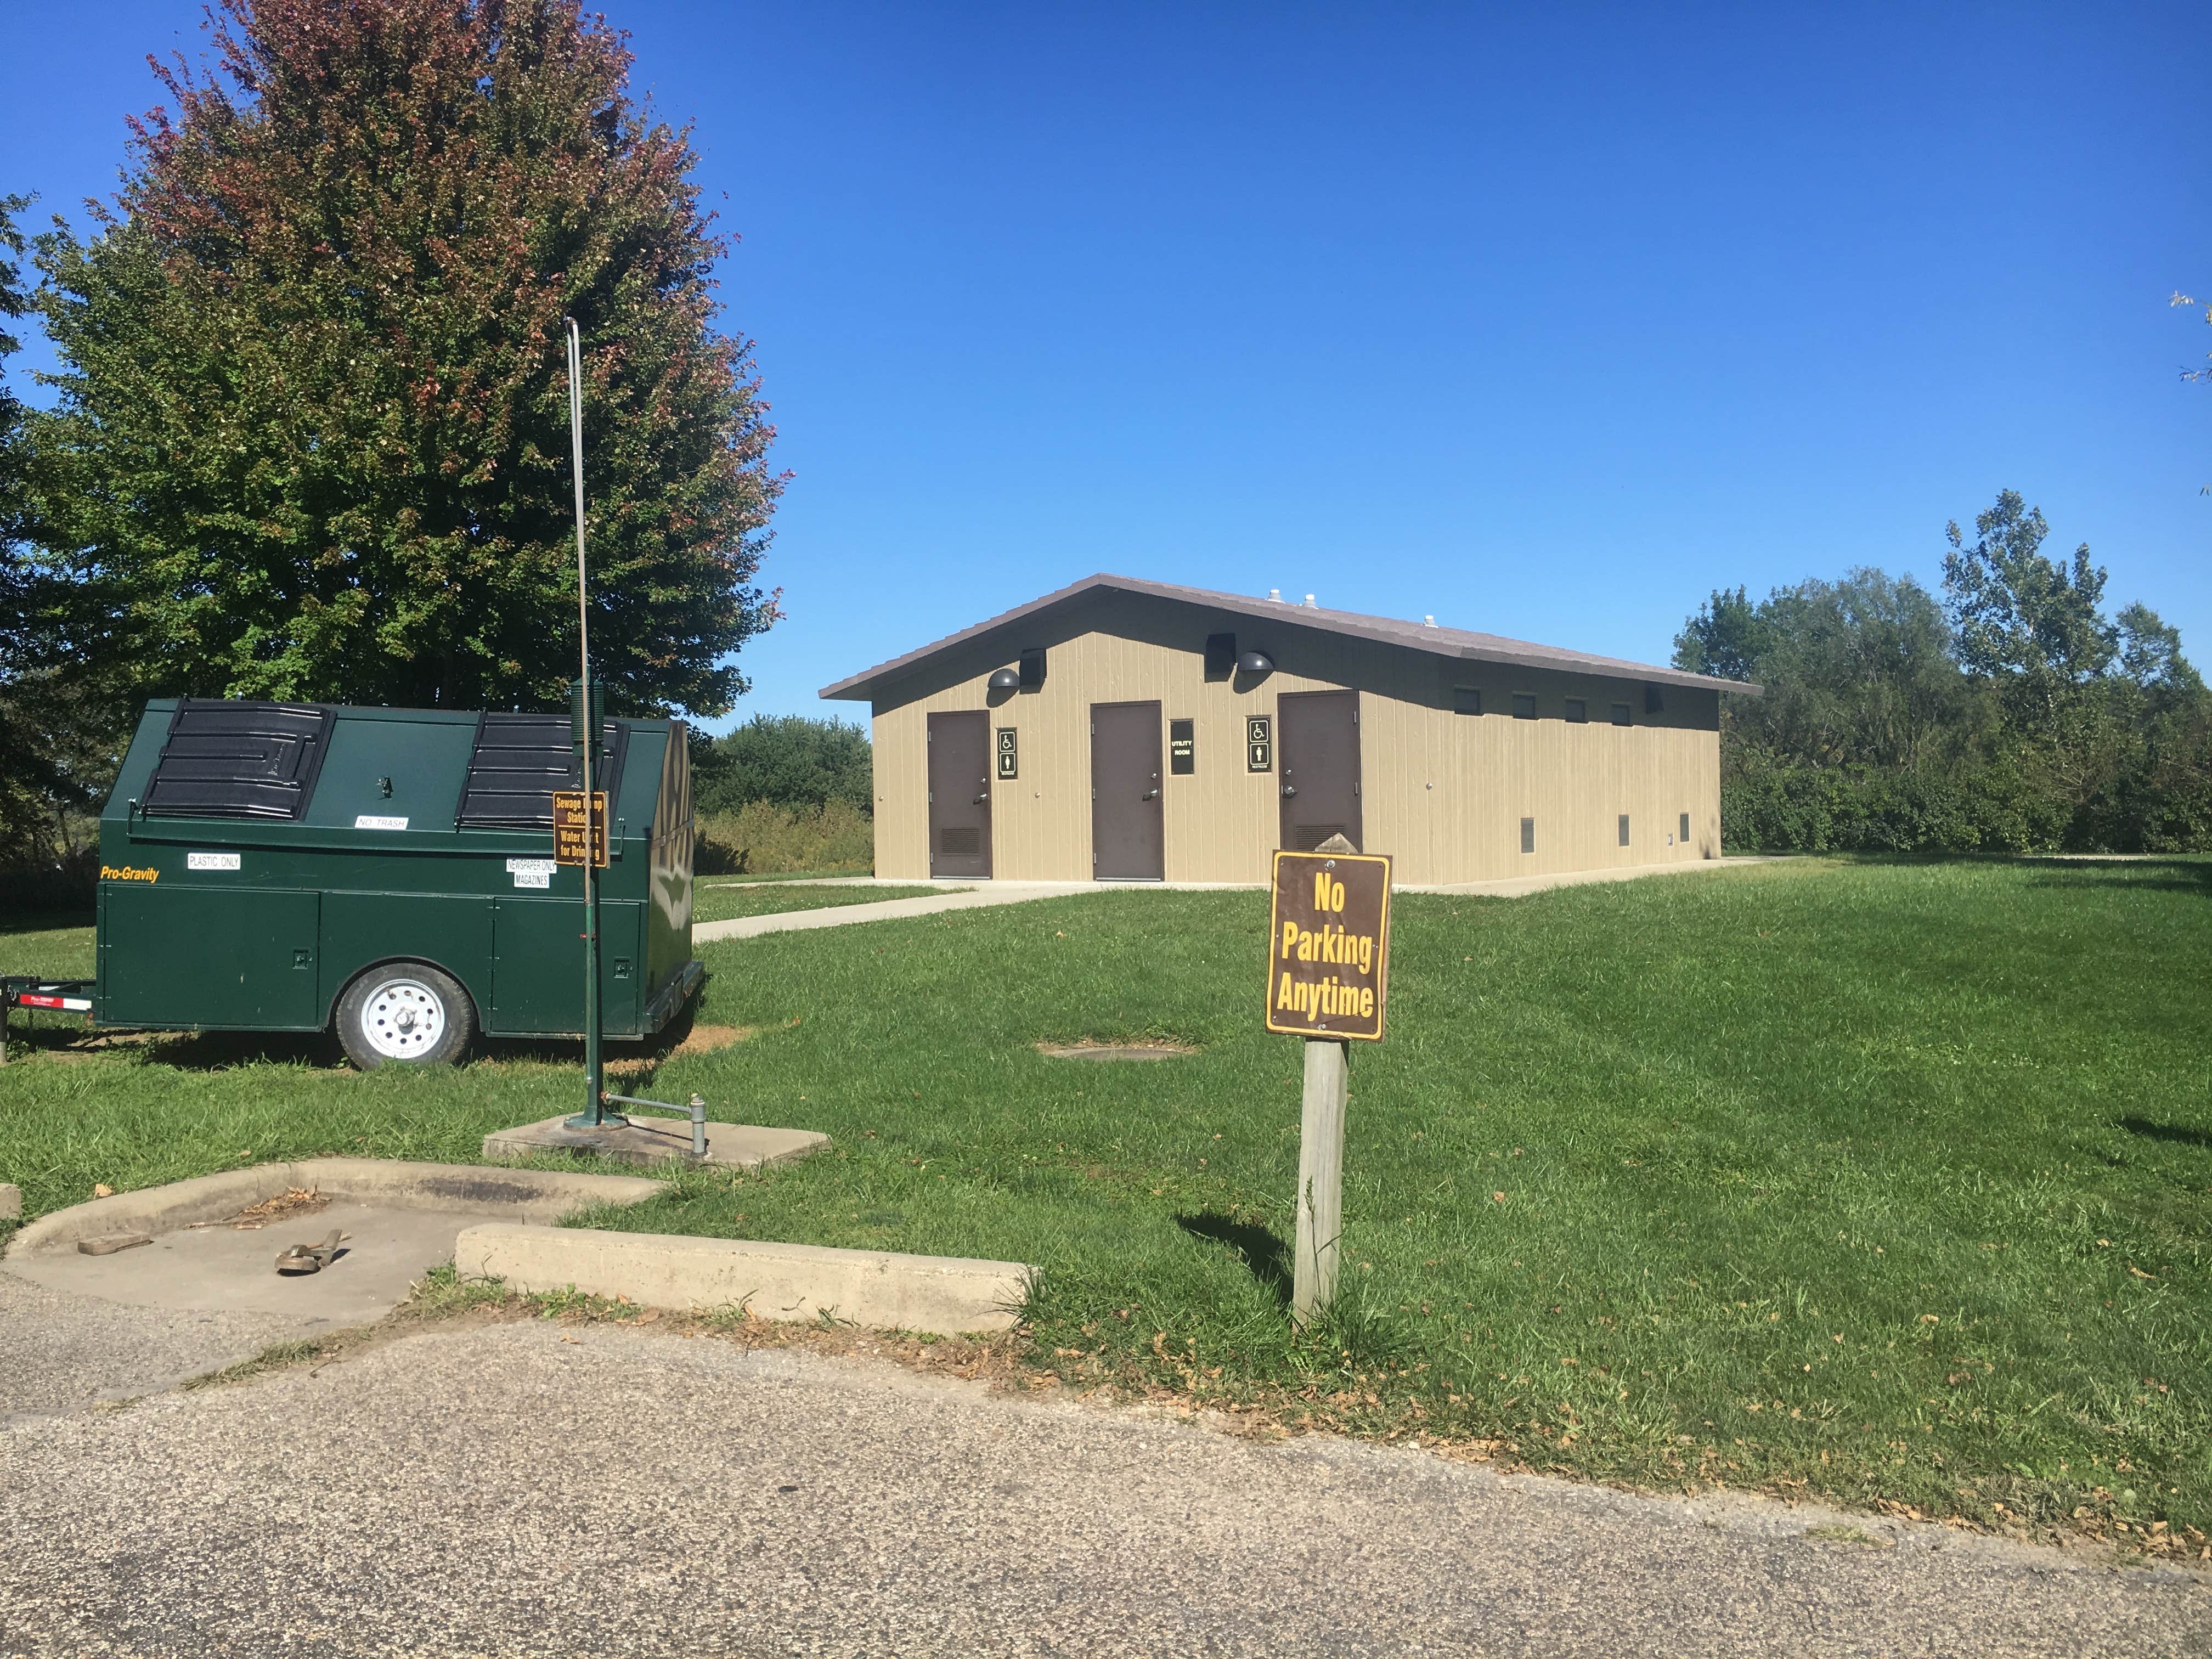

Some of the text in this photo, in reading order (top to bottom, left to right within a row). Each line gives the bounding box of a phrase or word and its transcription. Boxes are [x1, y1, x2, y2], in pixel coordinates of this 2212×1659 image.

[556, 797, 582, 811] Sewage
[377, 819, 405, 827] TRASH
[560, 830, 580, 843] Water
[560, 844, 570, 856] for
[190, 856, 238, 867] PLASTIC ONLY
[508, 859, 555, 871] NEWSPAPER ONLY
[100, 866, 160, 883] Pro-Gravity
[516, 874, 548, 885] MAGAZINES
[1314, 872, 1345, 912] No
[1282, 921, 1372, 975] Parking
[1277, 972, 1374, 1022] Anytime
